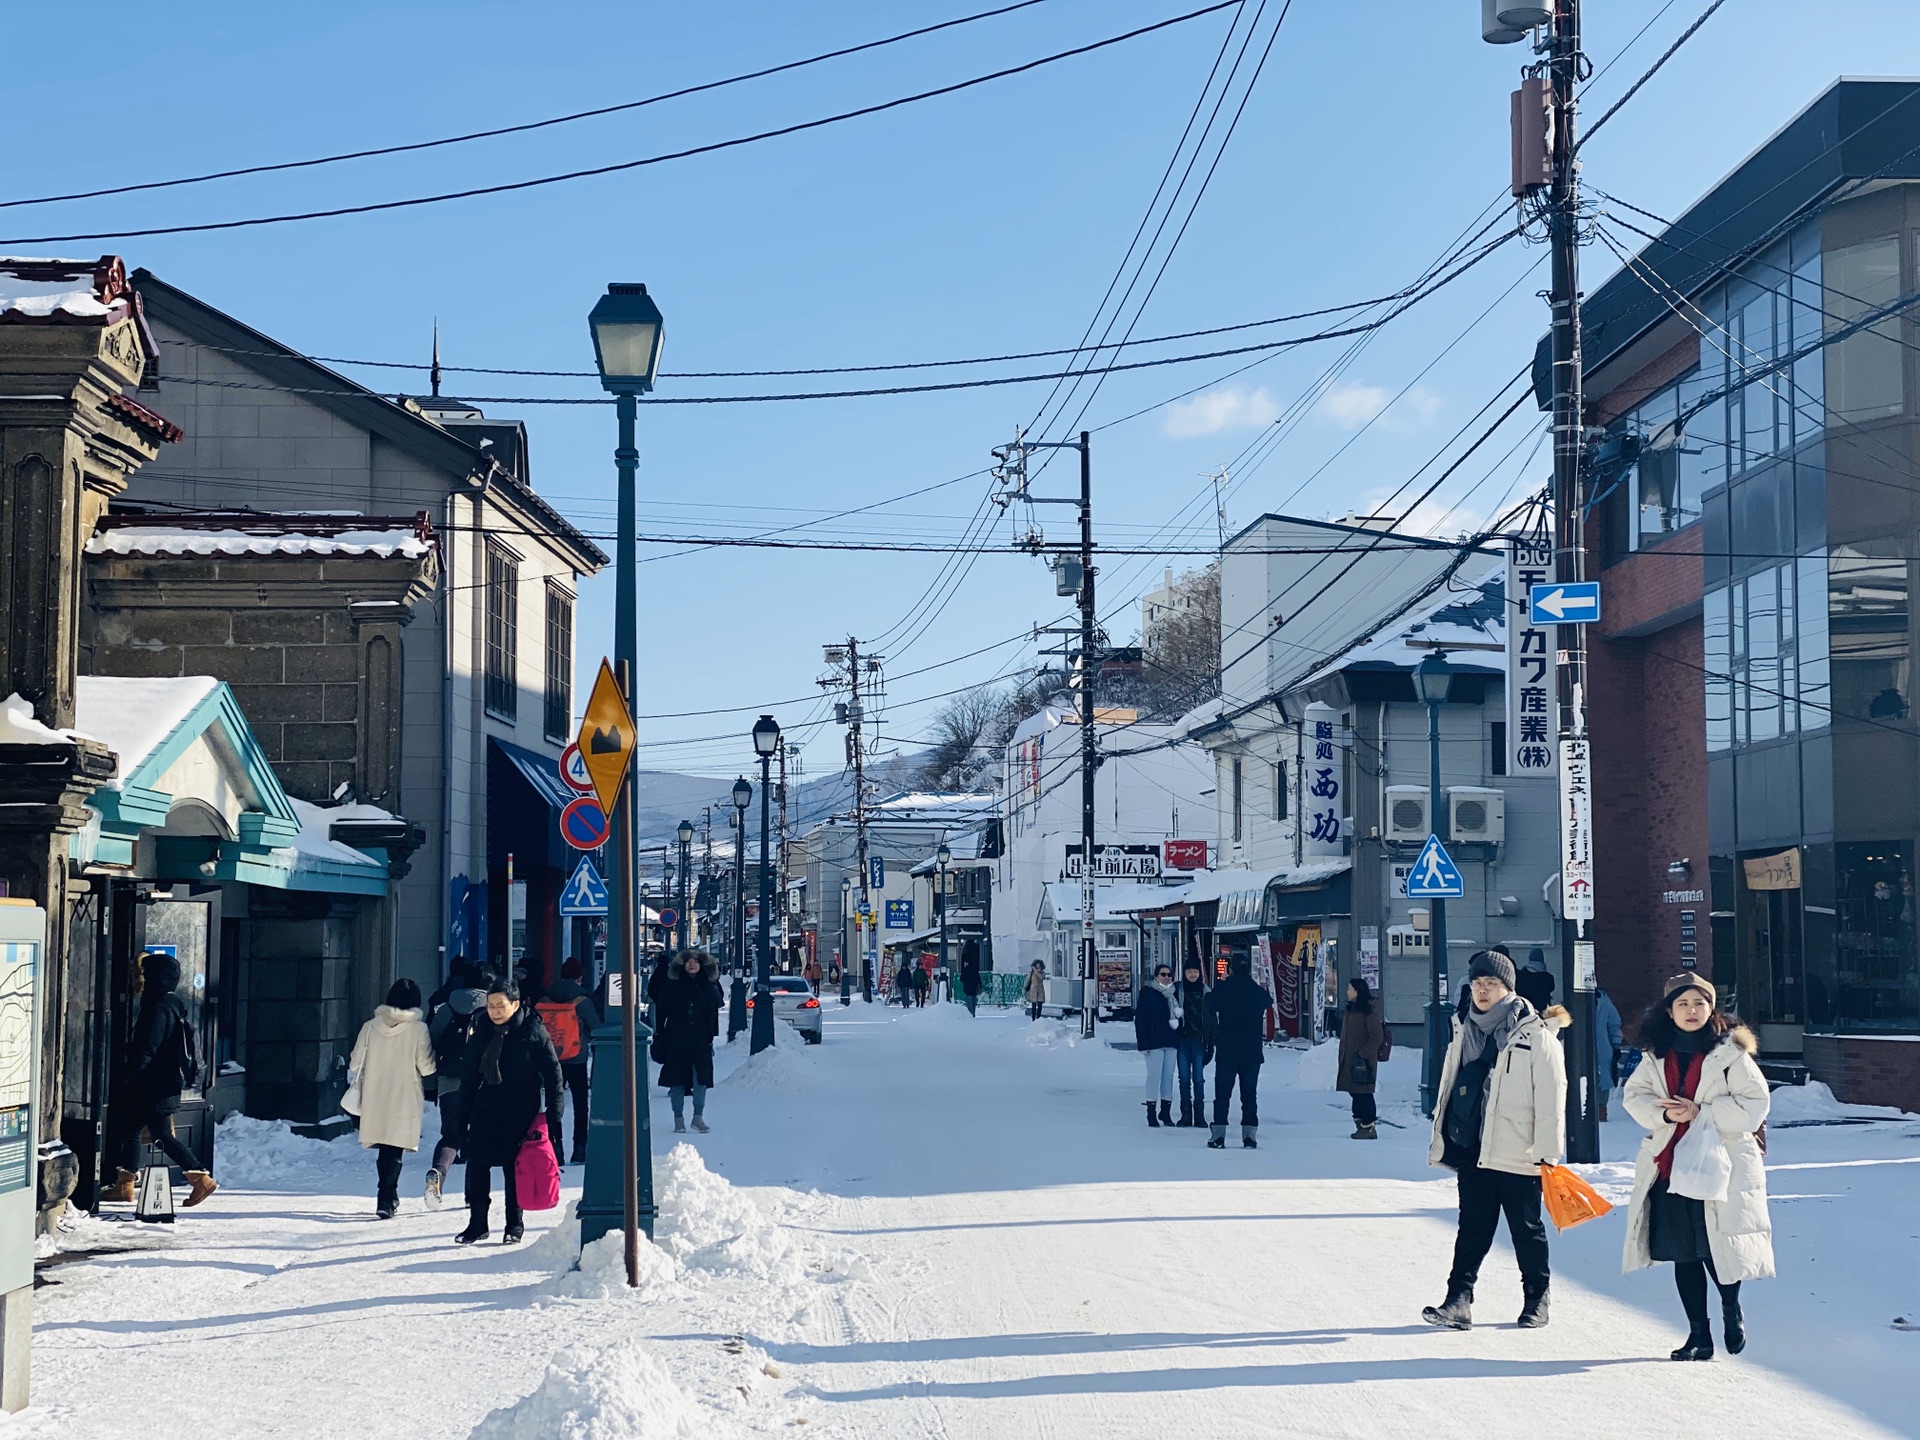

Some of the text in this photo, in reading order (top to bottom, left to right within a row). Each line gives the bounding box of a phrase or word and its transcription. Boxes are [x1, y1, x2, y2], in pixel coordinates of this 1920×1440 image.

[1515, 541, 1550, 565] BIG
[571, 754, 588, 778] 4
[1168, 845, 1204, 857] ラーメン
